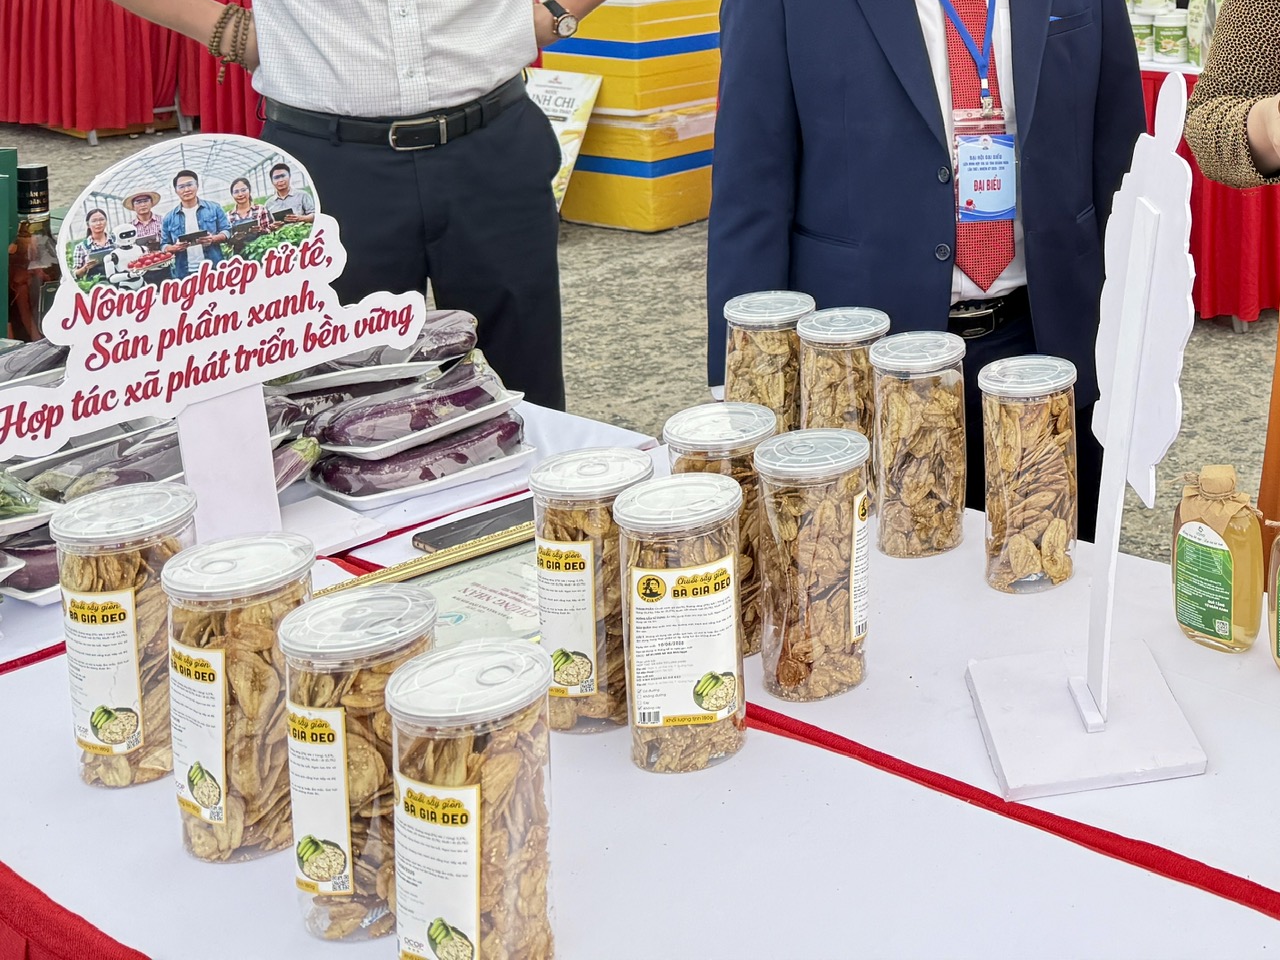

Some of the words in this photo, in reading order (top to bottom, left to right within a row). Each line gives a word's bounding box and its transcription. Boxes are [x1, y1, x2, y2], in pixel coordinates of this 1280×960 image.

[974, 179, 984, 194] ĐẠI
[987, 174, 1001, 191] BIỂU
[61, 287, 157, 331] Nông
[162, 257, 258, 313] nghiệp
[264, 244, 297, 279] tử
[298, 228, 332, 268] tế,
[84, 325, 153, 372] Sản
[156, 301, 242, 361] phẩm
[247, 280, 325, 328] xanh,
[0, 399, 64, 442] Hợp
[71, 384, 118, 418] tác
[125, 369, 163, 406] xã
[166, 353, 231, 403] phát
[234, 327, 300, 379] triển
[303, 316, 350, 354] bền
[353, 303, 415, 347] vững
[546, 557, 561, 571] GIÀ
[564, 561, 586, 571] ĐEO
[673, 586, 687, 598] BÀ
[691, 582, 710, 596] GIÀ
[714, 576, 731, 592] ĐEO
[81, 612, 97, 623] GIÀ
[101, 612, 126, 623] ĐEO
[194, 671, 216, 682] ĐEO
[292, 727, 307, 742] GIÀ
[310, 732, 335, 743] ĐEO
[404, 800, 416, 816] BÀ
[420, 806, 437, 823] GIÀ
[442, 814, 469, 825] ĐEO
